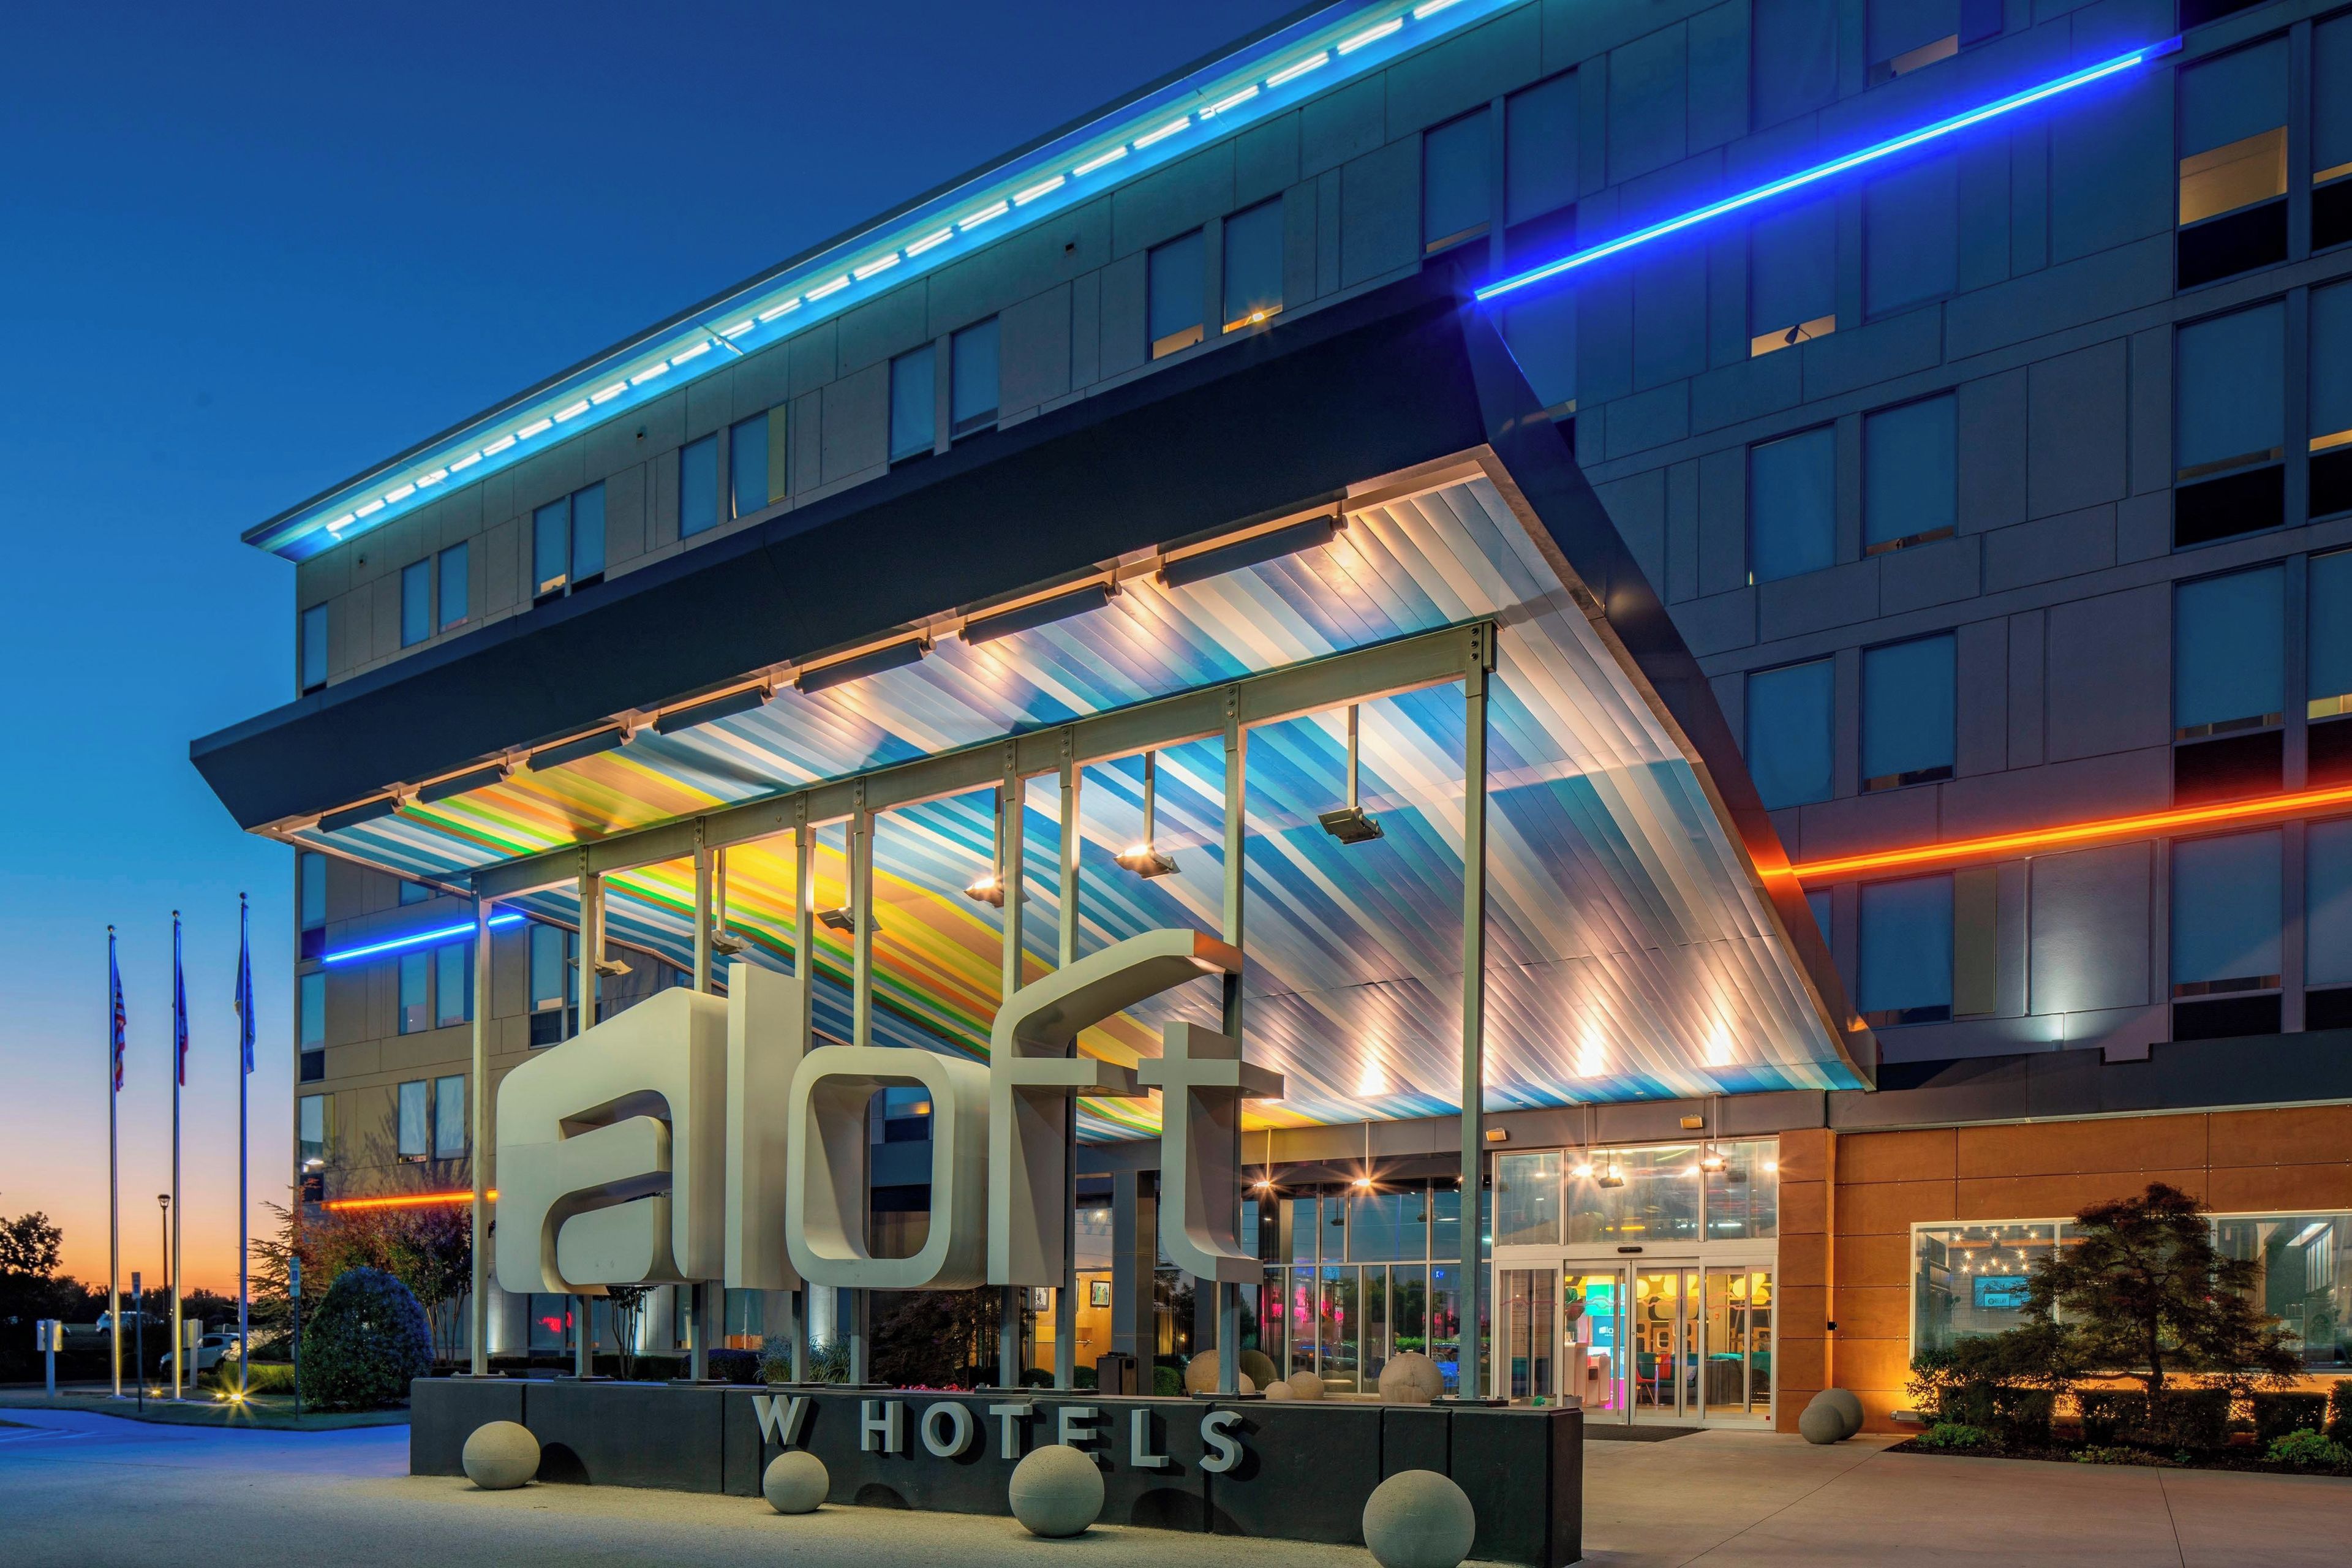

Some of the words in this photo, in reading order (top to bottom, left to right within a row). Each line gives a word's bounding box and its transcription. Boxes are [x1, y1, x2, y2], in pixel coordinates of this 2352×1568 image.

[496, 928, 1285, 1294] aloft
[752, 1395, 810, 1446] W
[861, 1398, 1243, 1473] HOTELS
